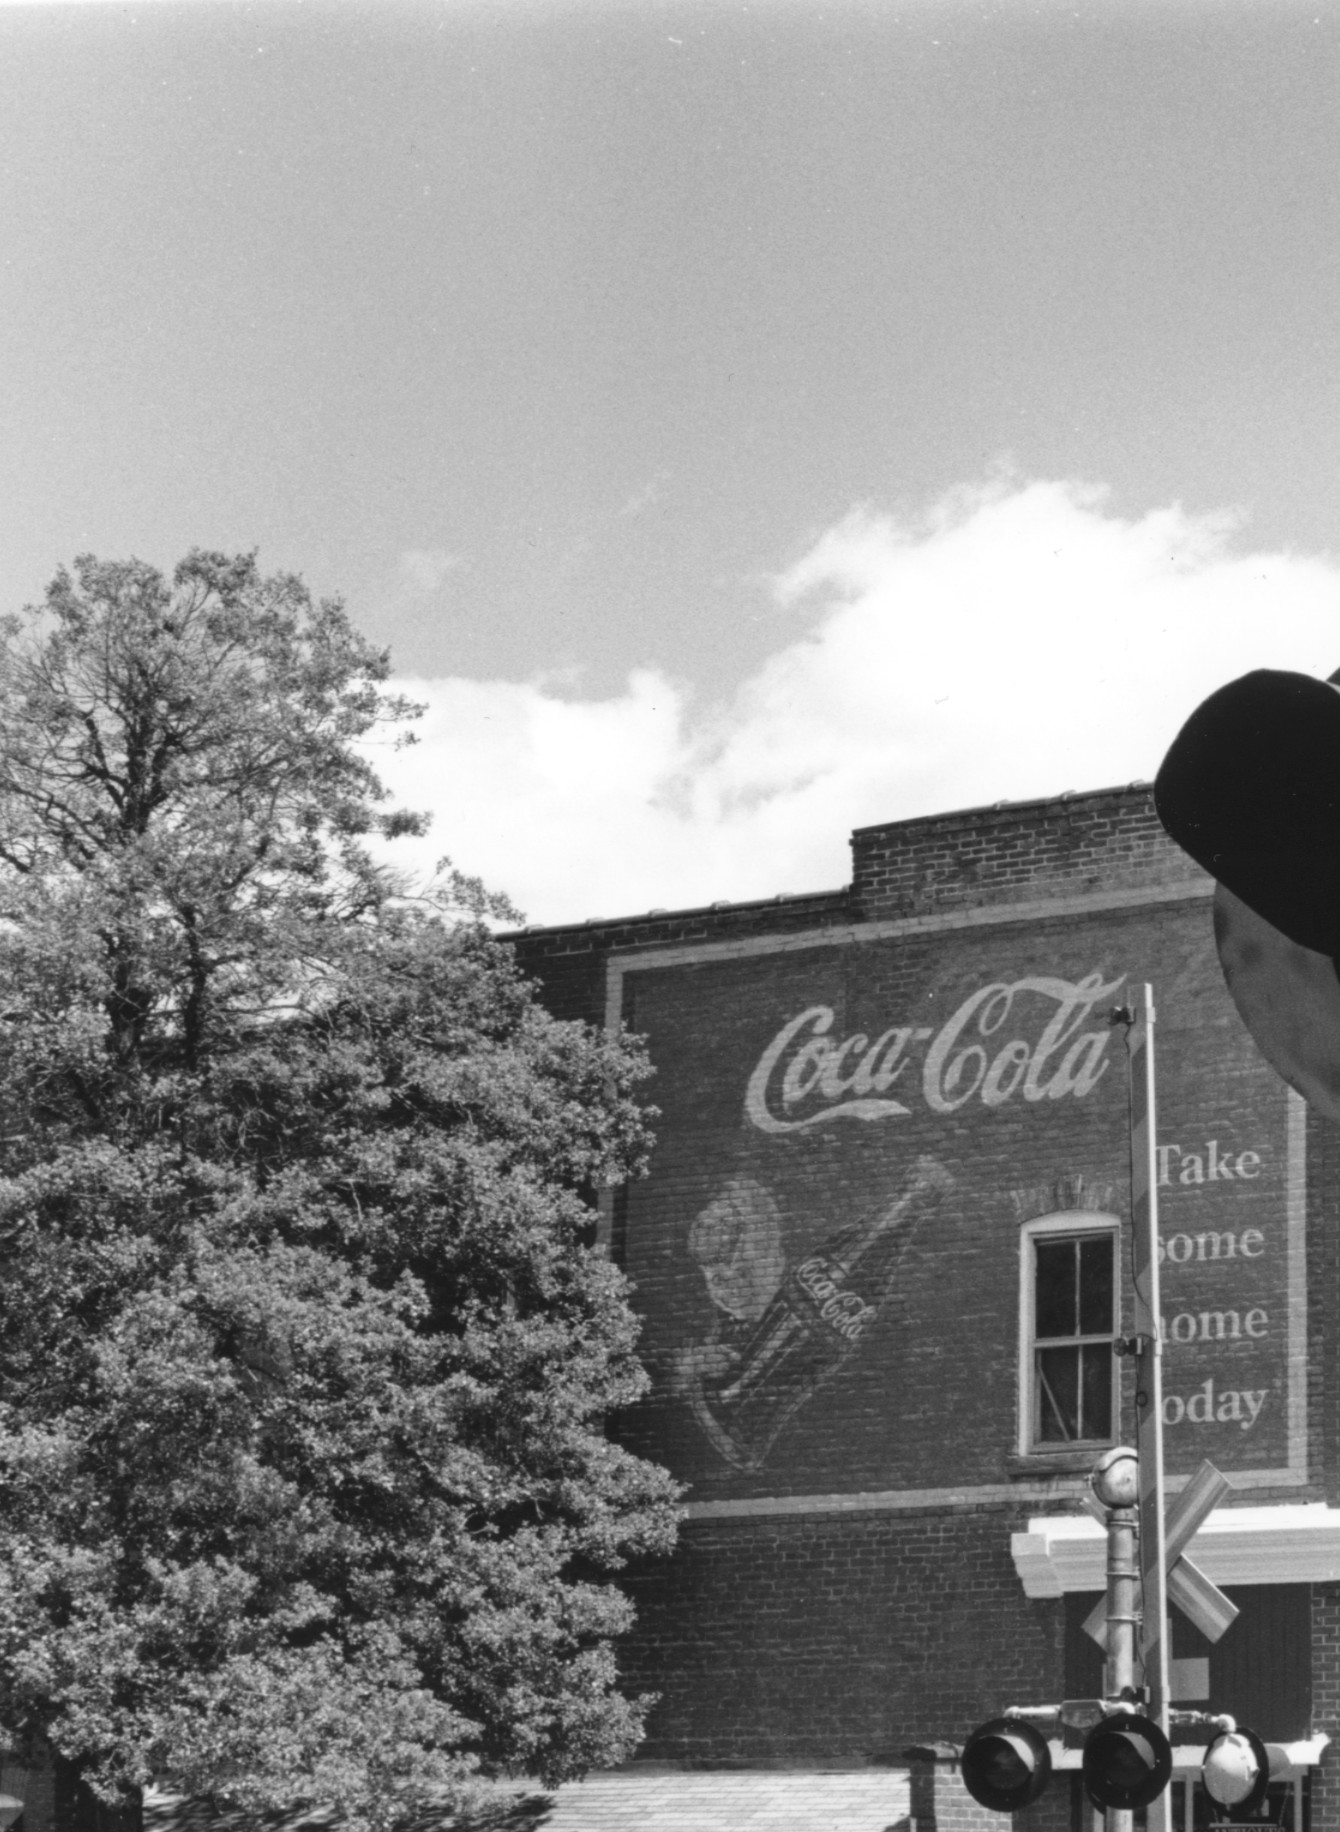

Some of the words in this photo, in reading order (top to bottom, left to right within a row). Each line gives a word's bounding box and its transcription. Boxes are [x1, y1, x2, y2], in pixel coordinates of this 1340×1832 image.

[744, 974, 1127, 1133] Coca-Cola
[1156, 1140, 1260, 1186] Take
[1161, 1378, 1269, 1430] oday
